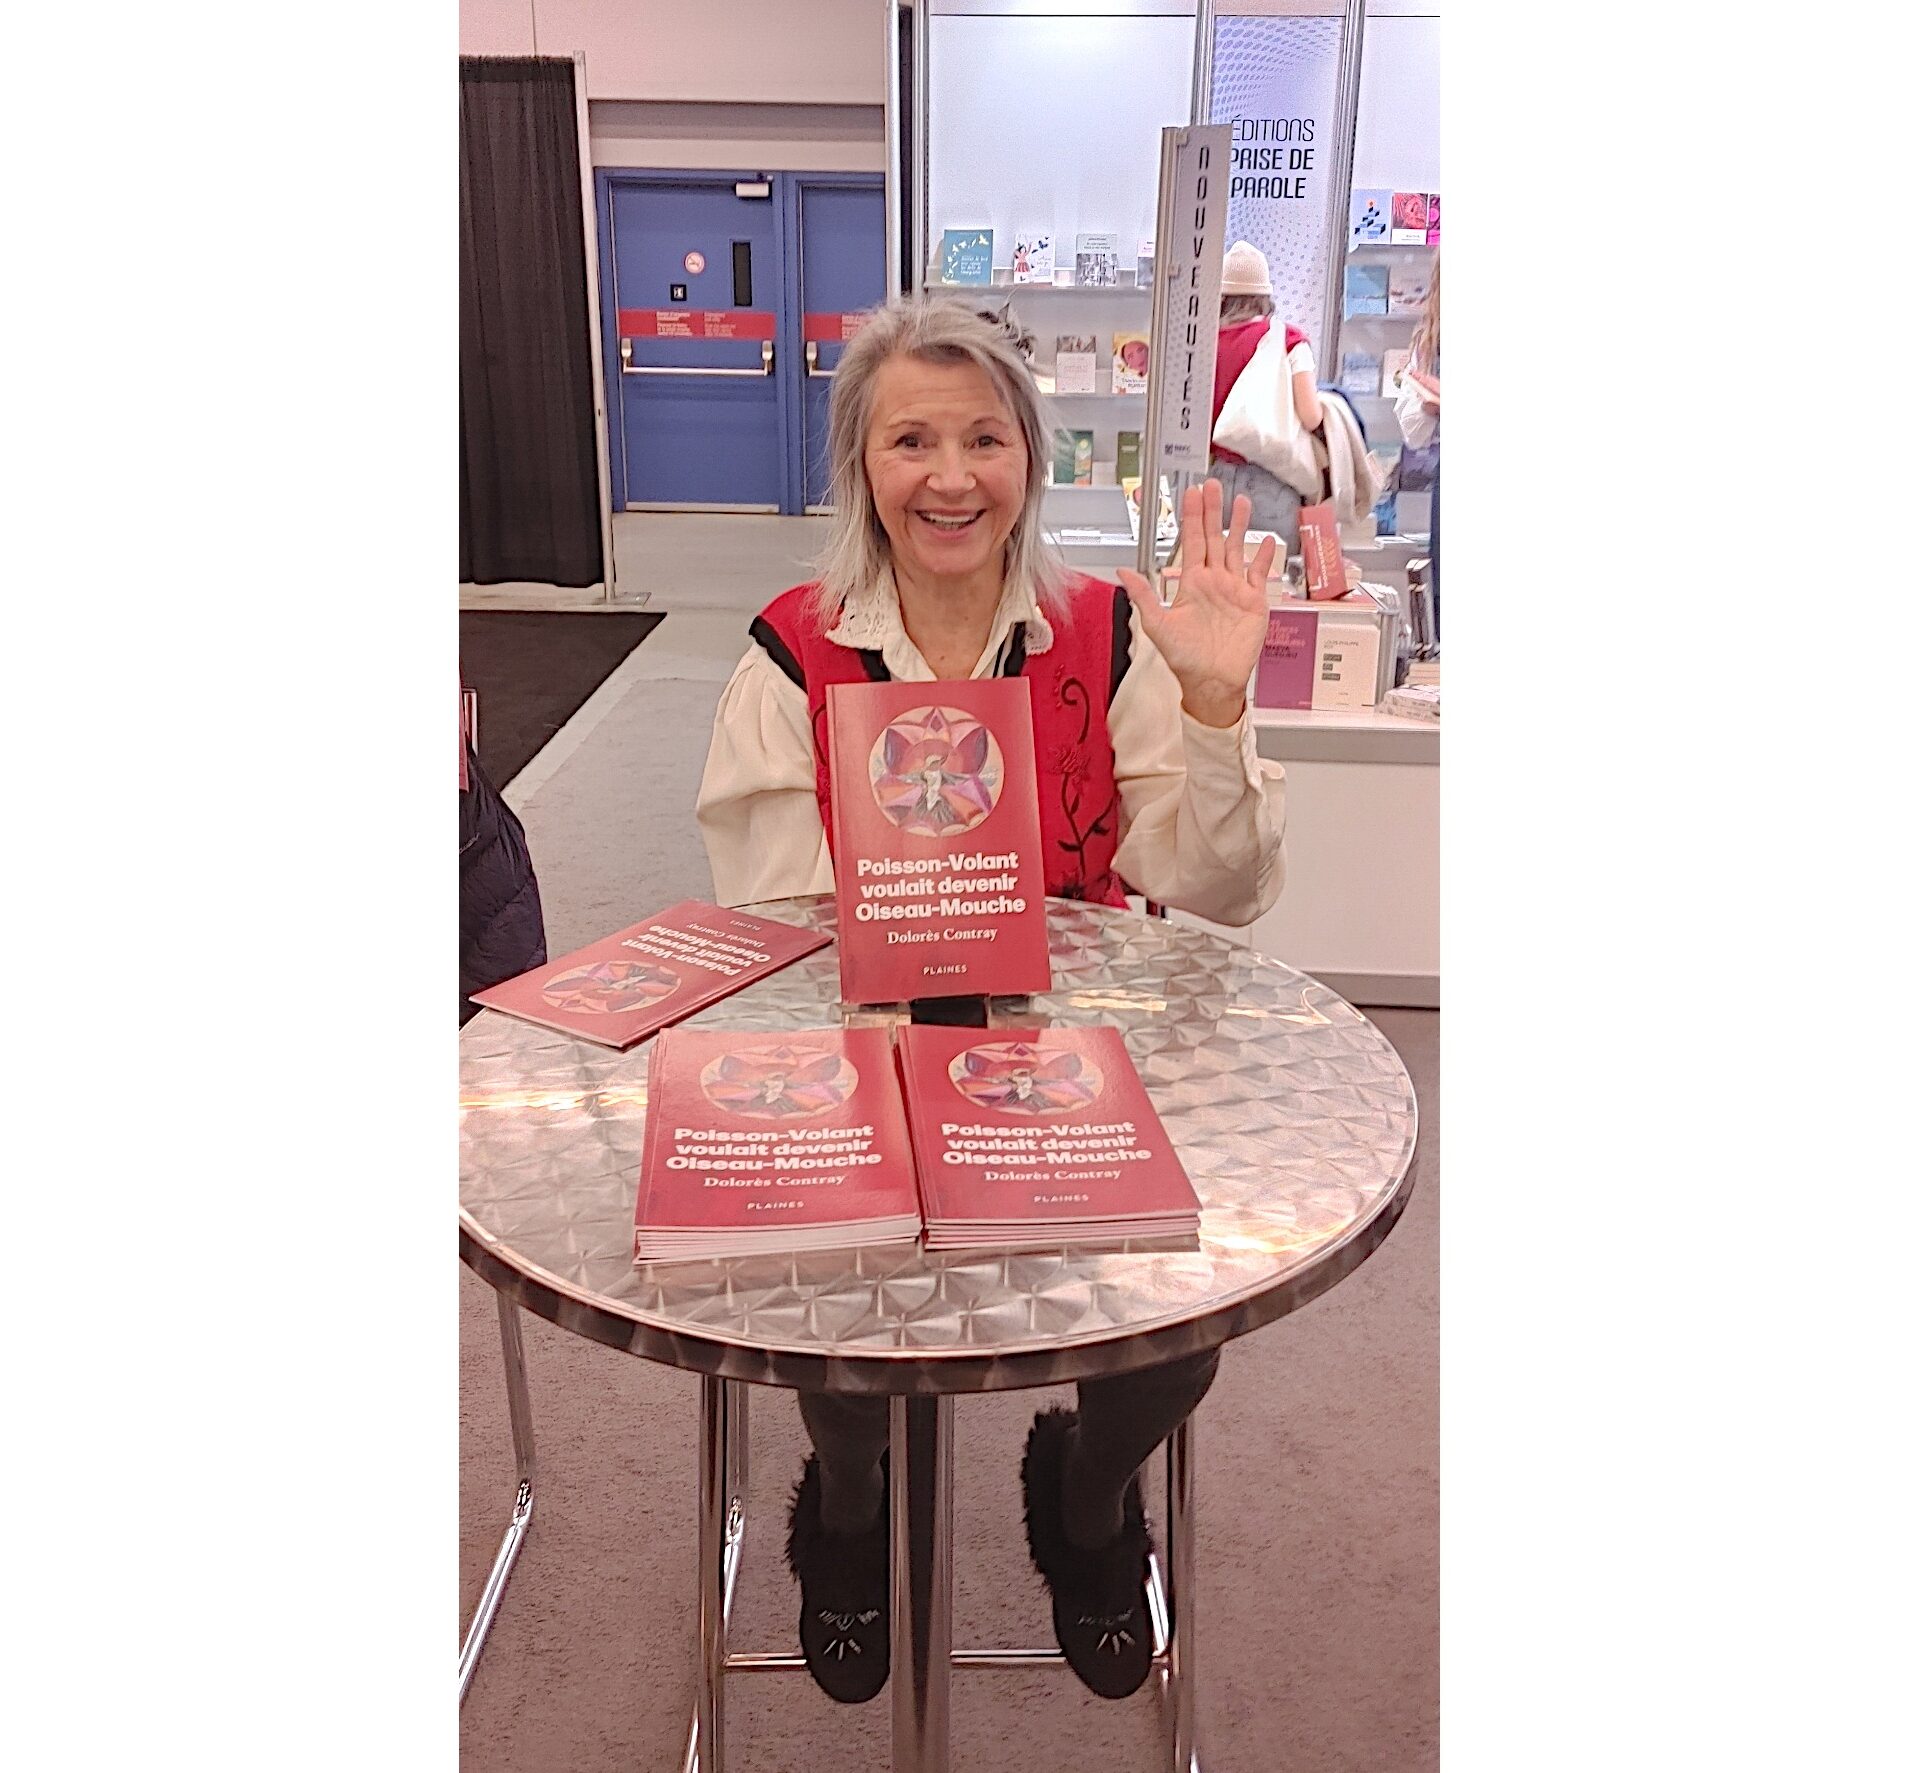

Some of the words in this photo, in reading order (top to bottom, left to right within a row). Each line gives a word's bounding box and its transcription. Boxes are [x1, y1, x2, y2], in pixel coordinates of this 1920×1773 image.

[1231, 114, 1315, 142] ÉDITIONS
[1231, 148, 1283, 170] PRISE
[1289, 148, 1315, 170] DE
[1231, 177, 1307, 199] PAROLE
[857, 852, 1019, 876] Poisson-Volant
[860, 878, 935, 898] voulait
[938, 873, 1018, 894] devenir
[855, 895, 1026, 921] Oiseau-Mouche
[636, 933, 699, 953] devenir
[648, 925, 772, 963] Oiseau-Mouche
[887, 930, 940, 944] Dolorès
[943, 928, 998, 941] Contray
[620, 938, 742, 976] Poisson-Volant
[699, 948, 753, 968] voulait
[923, 964, 968, 976] PLAINES
[674, 1125, 874, 1142] Poisson-Volant
[941, 1122, 1136, 1137] Poisson-Volant
[675, 1143, 769, 1156] voulait
[772, 1139, 873, 1155] devenir
[947, 1138, 1039, 1151] voulait
[1041, 1135, 1137, 1151] devenir
[666, 1153, 882, 1170] Oiseau-Mouche
[942, 1149, 1152, 1165] Oiseau-Mouche
[703, 1176, 771, 1188] Dolorès
[776, 1174, 846, 1187] Contray
[984, 1170, 1050, 1181] Dolorès
[1054, 1169, 1121, 1181] Contray
[747, 1200, 804, 1210] PLAINES
[1033, 1194, 1089, 1203] PLAINES
